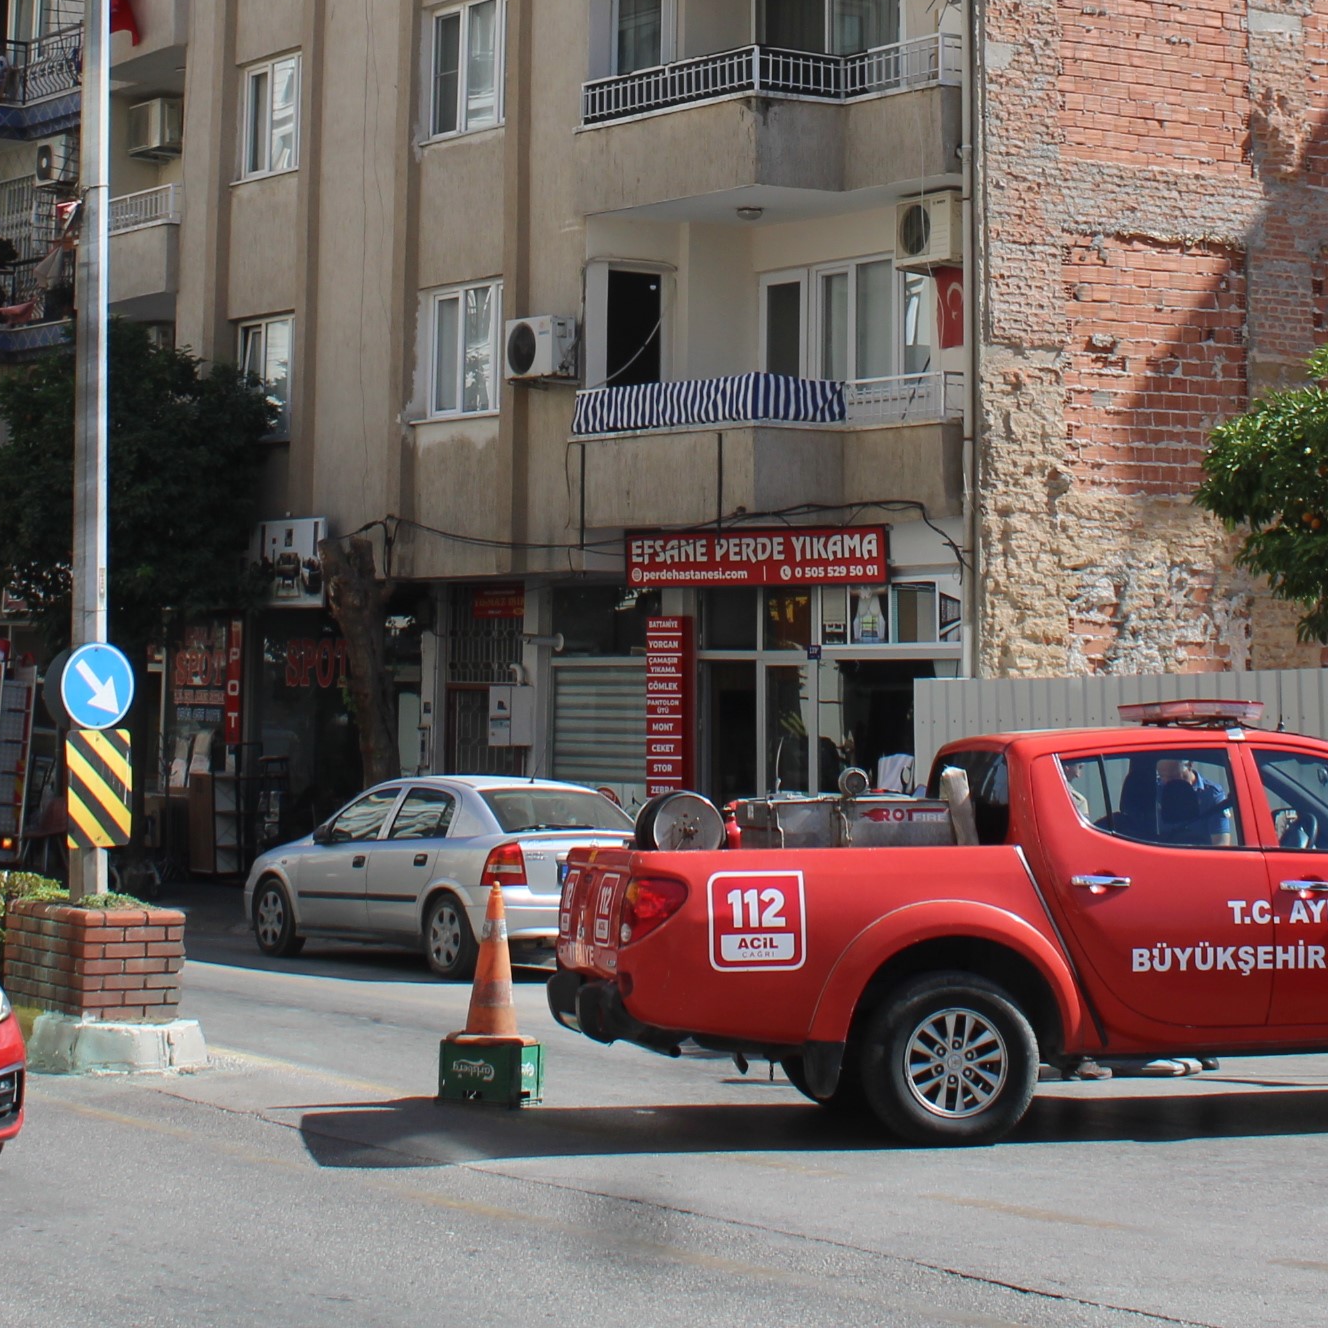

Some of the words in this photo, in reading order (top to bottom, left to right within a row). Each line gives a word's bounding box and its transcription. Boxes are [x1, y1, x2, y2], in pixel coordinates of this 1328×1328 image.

[631, 538, 708, 565] EFSANE
[714, 536, 785, 564] PERDE
[790, 533, 878, 563] YIKAMA
[643, 567, 748, 582] perdehastanesi.com
[794, 567, 803, 578] 0
[804, 566, 824, 578] 505
[827, 566, 847, 578] 529
[849, 565, 864, 577] 50
[865, 564, 878, 576] 01
[648, 619, 678, 628] BATTANİYE
[648, 640, 679, 649] YORGAN
[648, 657, 678, 665] ÇAMAŞIR
[175, 649, 226, 686] SPOT
[647, 680, 678, 691] GÖMLEK
[656, 706, 670, 714] ÜTÜ
[652, 722, 674, 731] MONT
[651, 744, 675, 753] CEKET
[653, 763, 673, 772] STOR
[727, 887, 786, 929] 112
[1227, 899, 1280, 924] T.C.
[1131, 939, 1327, 977] BÜYÜKŞEHİR
